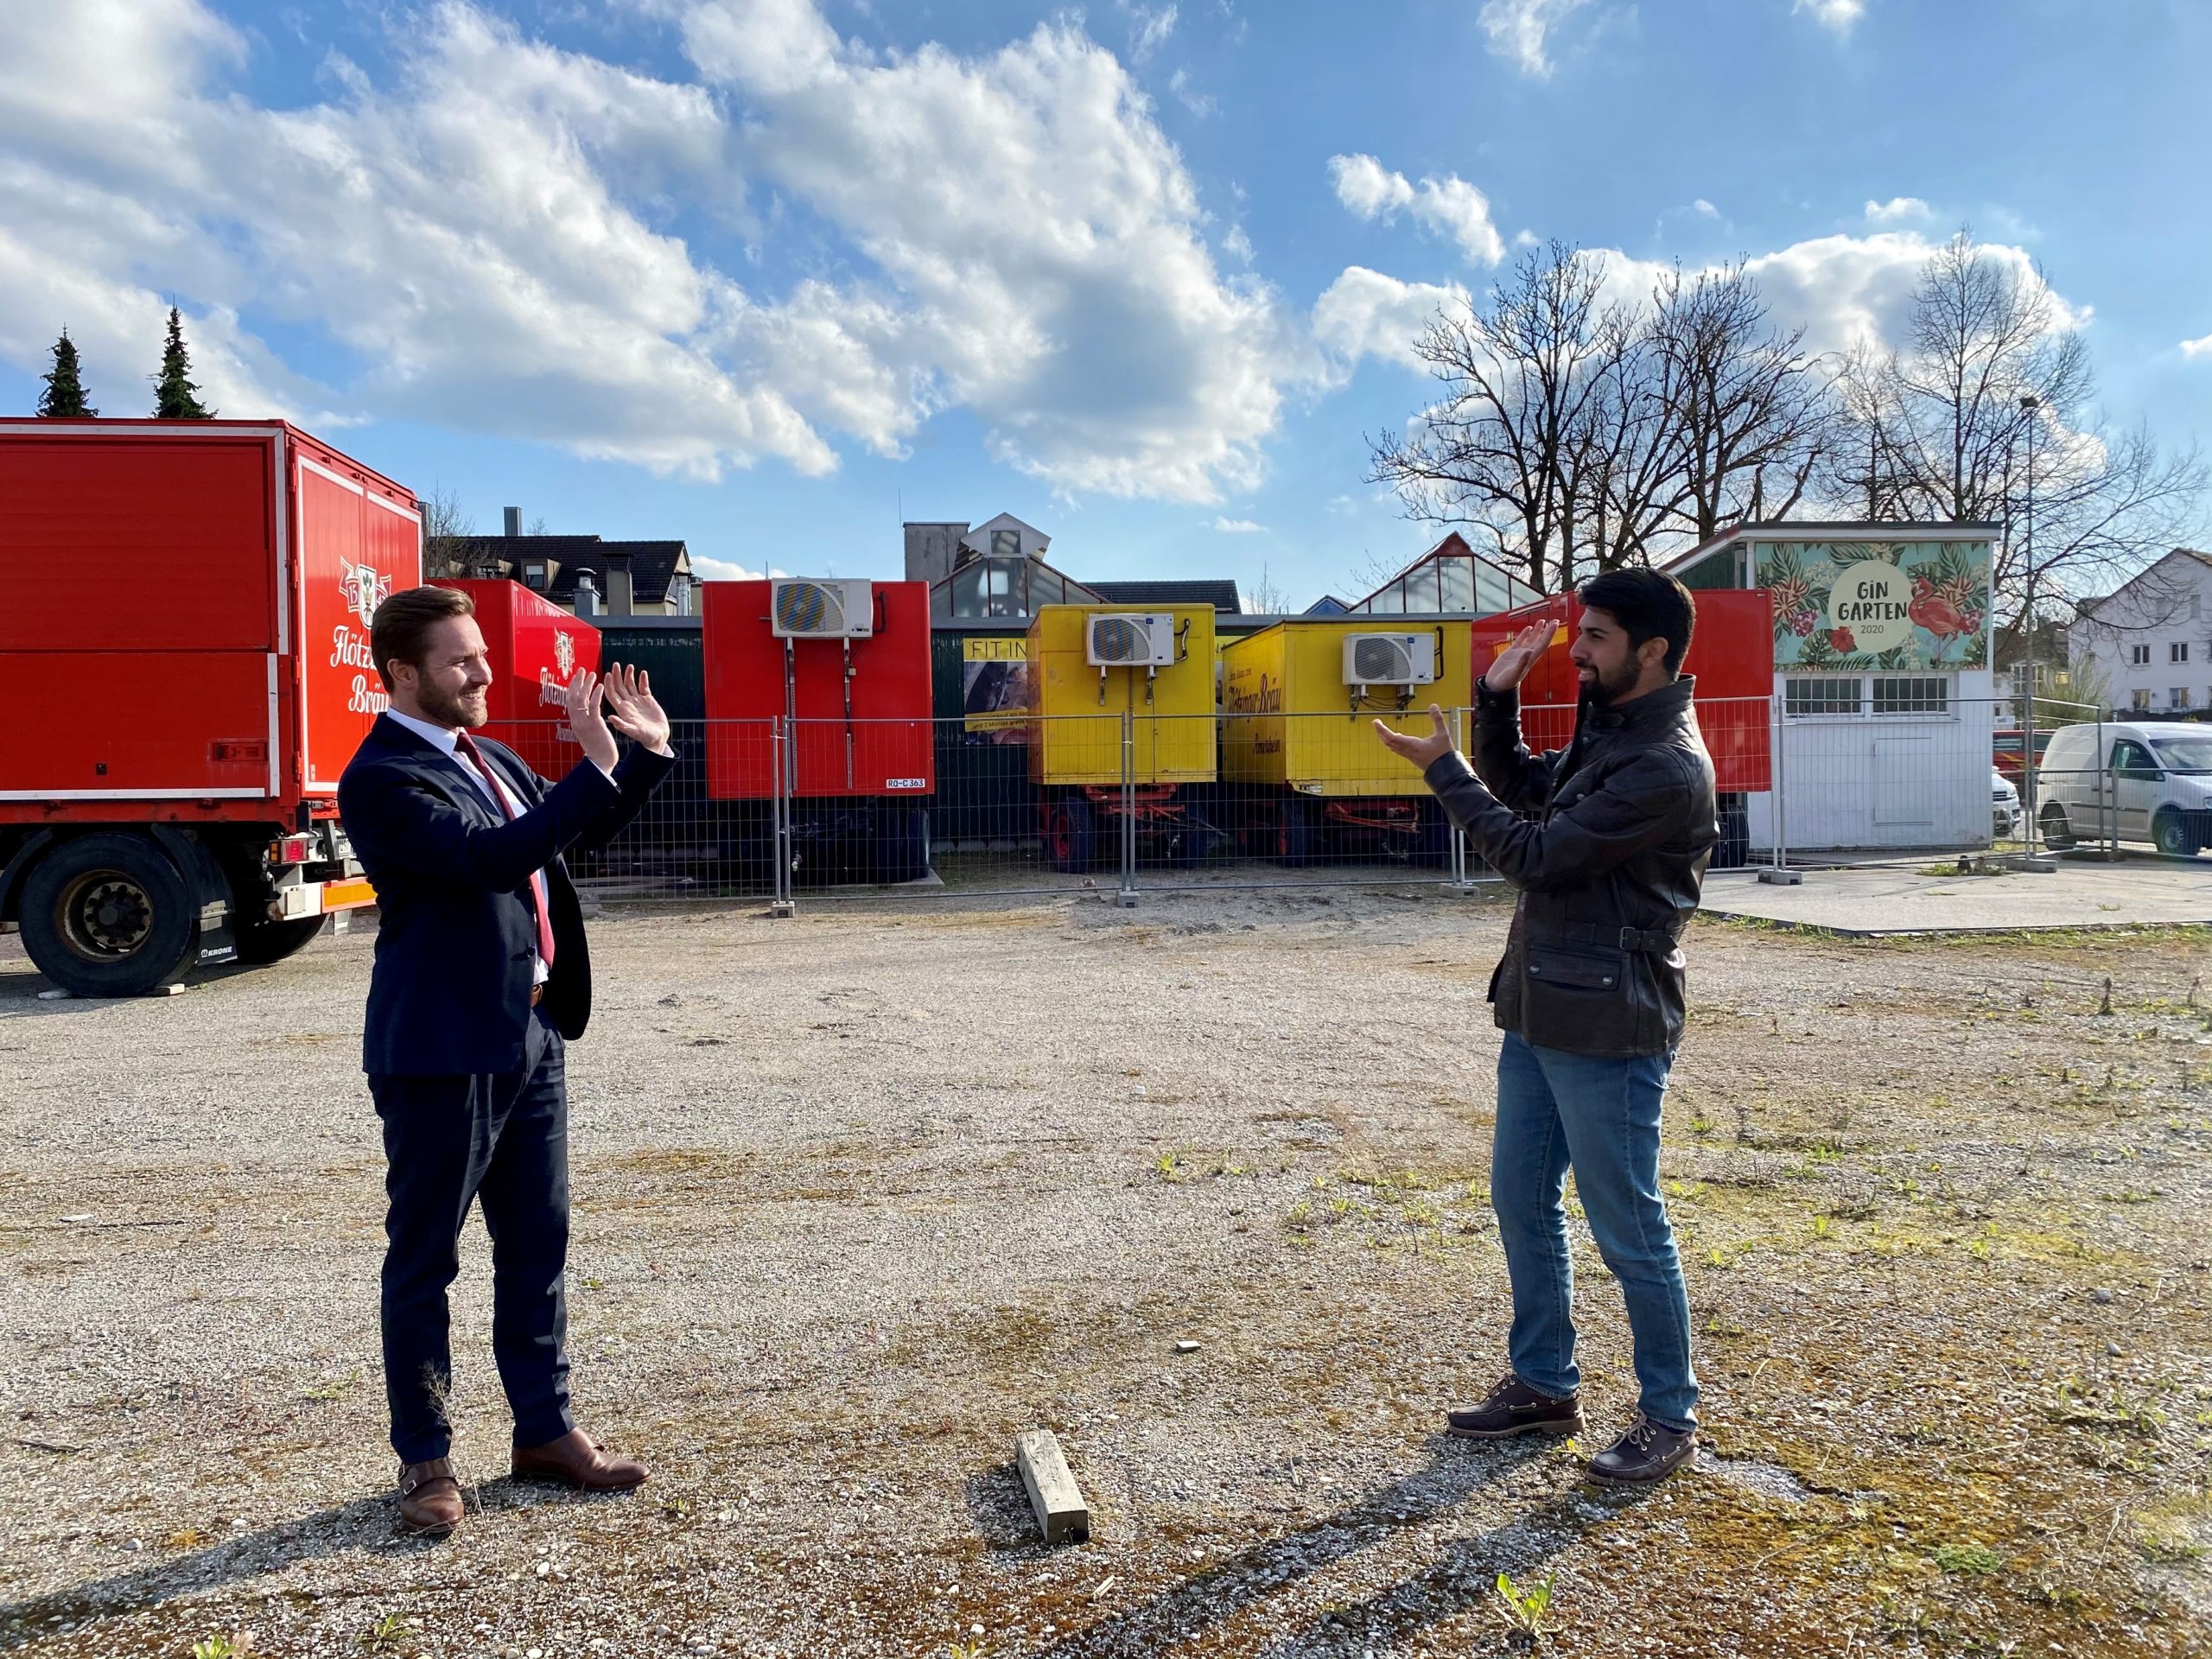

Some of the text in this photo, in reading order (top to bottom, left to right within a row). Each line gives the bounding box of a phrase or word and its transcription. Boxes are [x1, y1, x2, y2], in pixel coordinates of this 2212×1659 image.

[1838, 601, 1907, 621] GARTEN
[1860, 625, 1885, 634] 2020
[330, 625, 378, 671] Flötz
[972, 641, 1002, 658] FIT
[348, 674, 389, 715] Bräu
[909, 779, 924, 787] 363
[207, 946, 232, 957] KRONE
